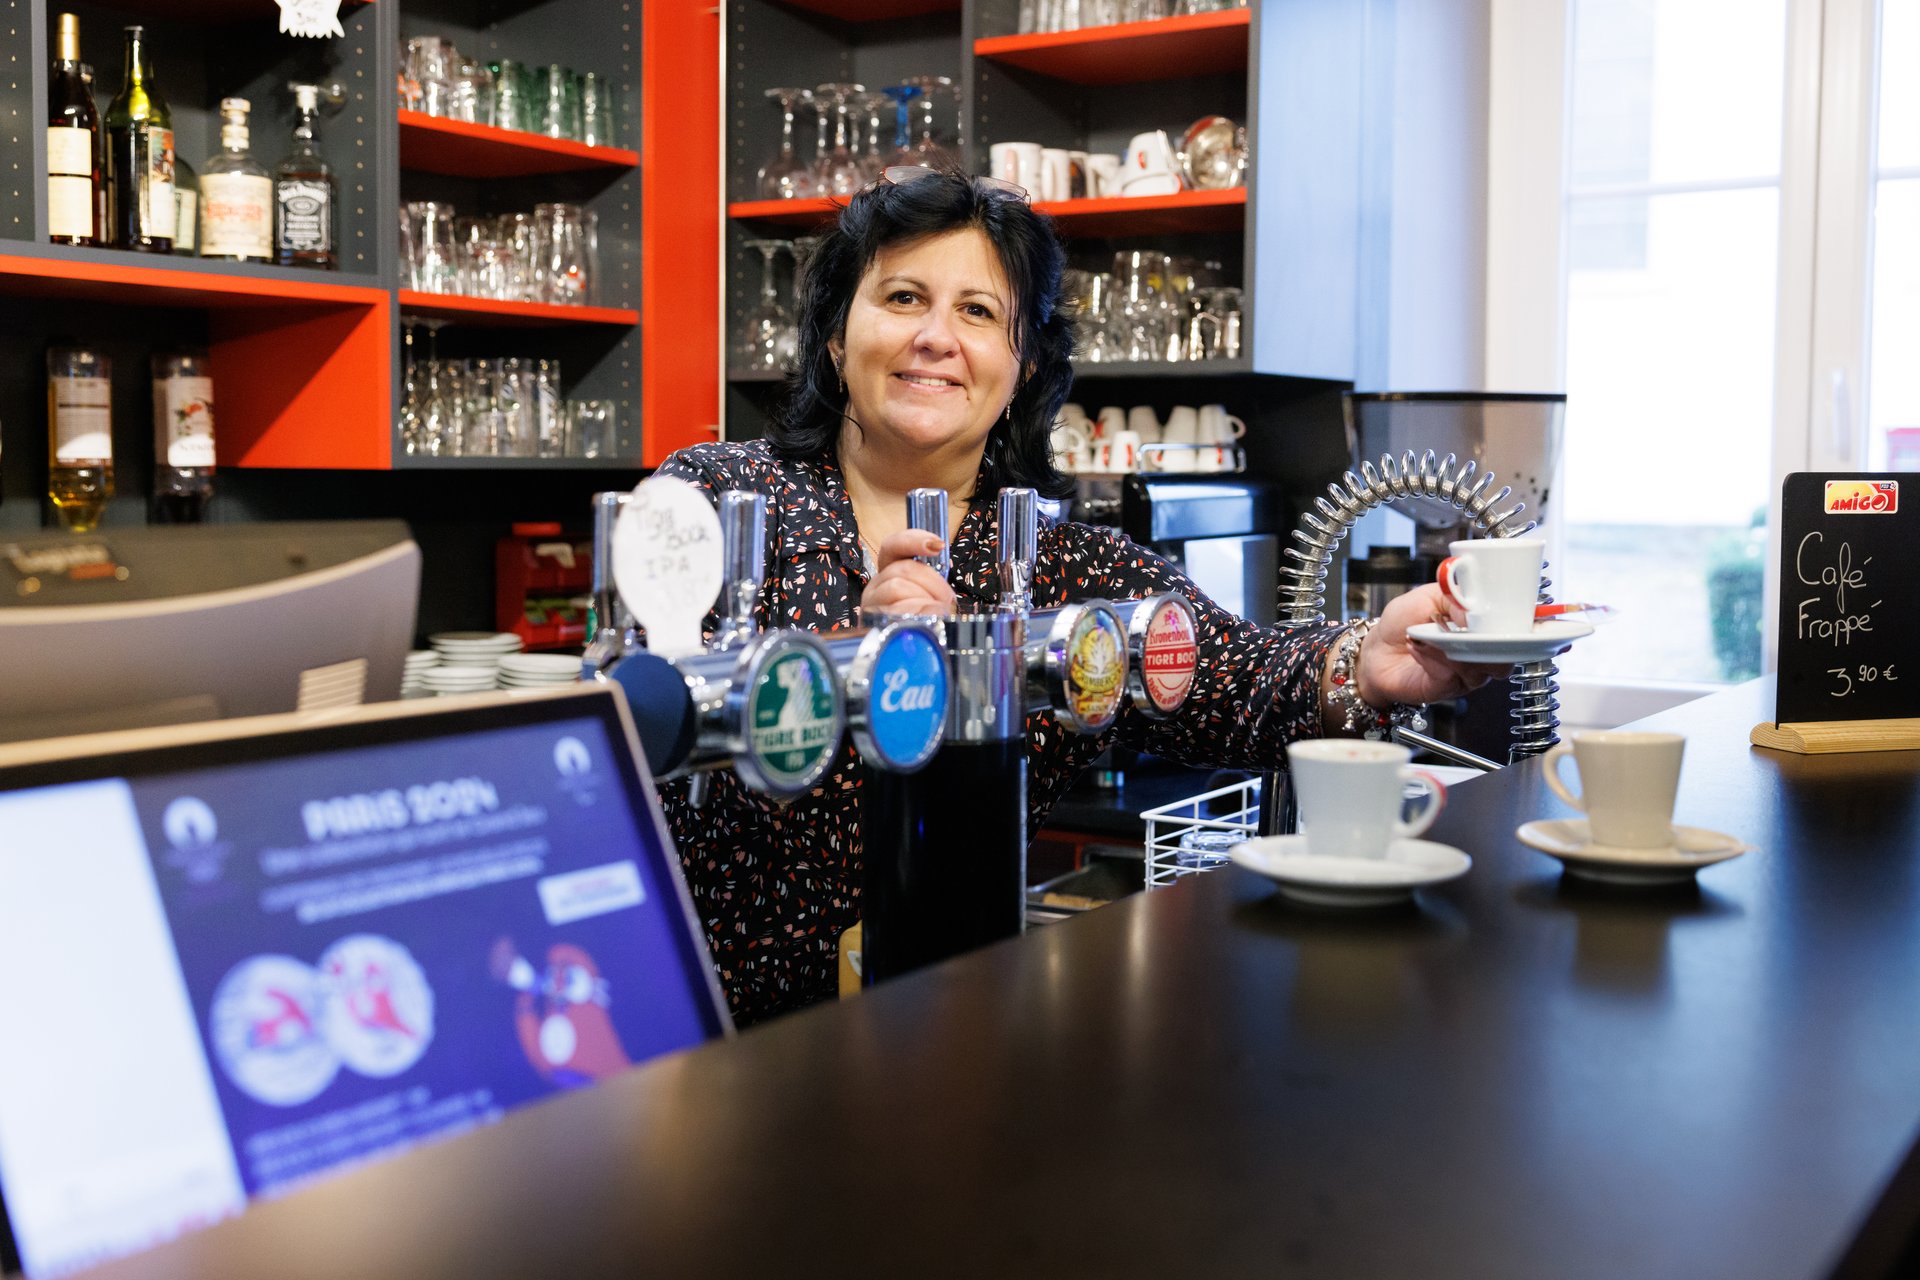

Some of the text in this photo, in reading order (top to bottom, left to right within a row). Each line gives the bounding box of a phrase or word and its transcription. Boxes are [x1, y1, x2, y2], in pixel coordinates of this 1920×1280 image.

[644, 554, 691, 580] IPA
[1797, 531, 1872, 614] Café
[1799, 597, 1882, 647] Frappé
[1146, 652, 1175, 666] TIGRE
[880, 668, 935, 713] Eau
